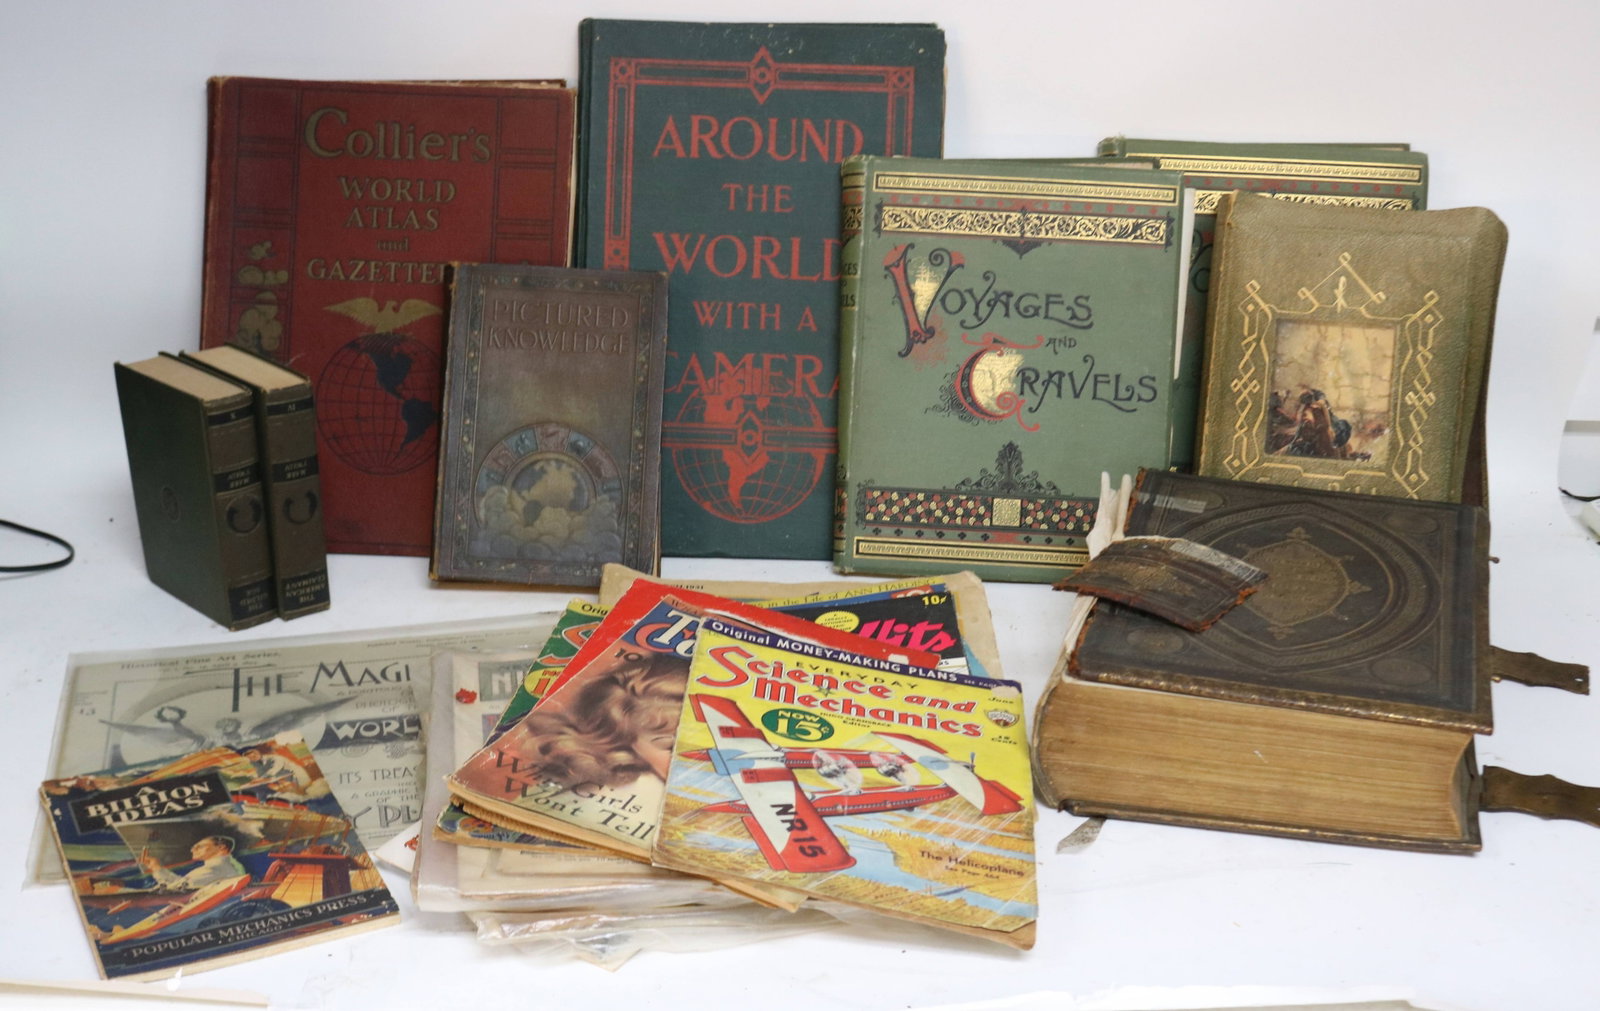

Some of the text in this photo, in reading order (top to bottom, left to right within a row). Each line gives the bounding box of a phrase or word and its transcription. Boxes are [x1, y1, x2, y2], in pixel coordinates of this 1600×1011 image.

[304, 107, 492, 163] Collier's
[653, 115, 865, 163] AROUND
[338, 175, 457, 204] WORLD
[721, 184, 796, 213] THE
[345, 207, 441, 231] ATLAS
[377, 238, 410, 252] and
[492, 299, 629, 328] PICTURED
[693, 300, 819, 332] WITH A
[487, 327, 625, 354] KNOWLEDGE
[1046, 335, 1077, 354] AND
[664, 351, 841, 398] AMER
[844, 586, 873, 598] ANN
[712, 621, 771, 645] Original
[776, 635, 902, 672] MONEY-MAKING
[908, 667, 959, 682] PLANS
[696, 645, 978, 715] Science and
[796, 661, 919, 689] EVERYDAY
[752, 677, 984, 738] Mechanics
[778, 710, 820, 723] NOW
[84, 780, 214, 819] BILLION
[101, 794, 205, 828] IDEAS
[569, 781, 643, 814] Girls
[599, 809, 656, 841] Tell
[920, 850, 1025, 877] The Helicoplane
[132, 893, 368, 958] POPULAR MECHANICS PRESS
[227, 924, 283, 944] CHICAGO
